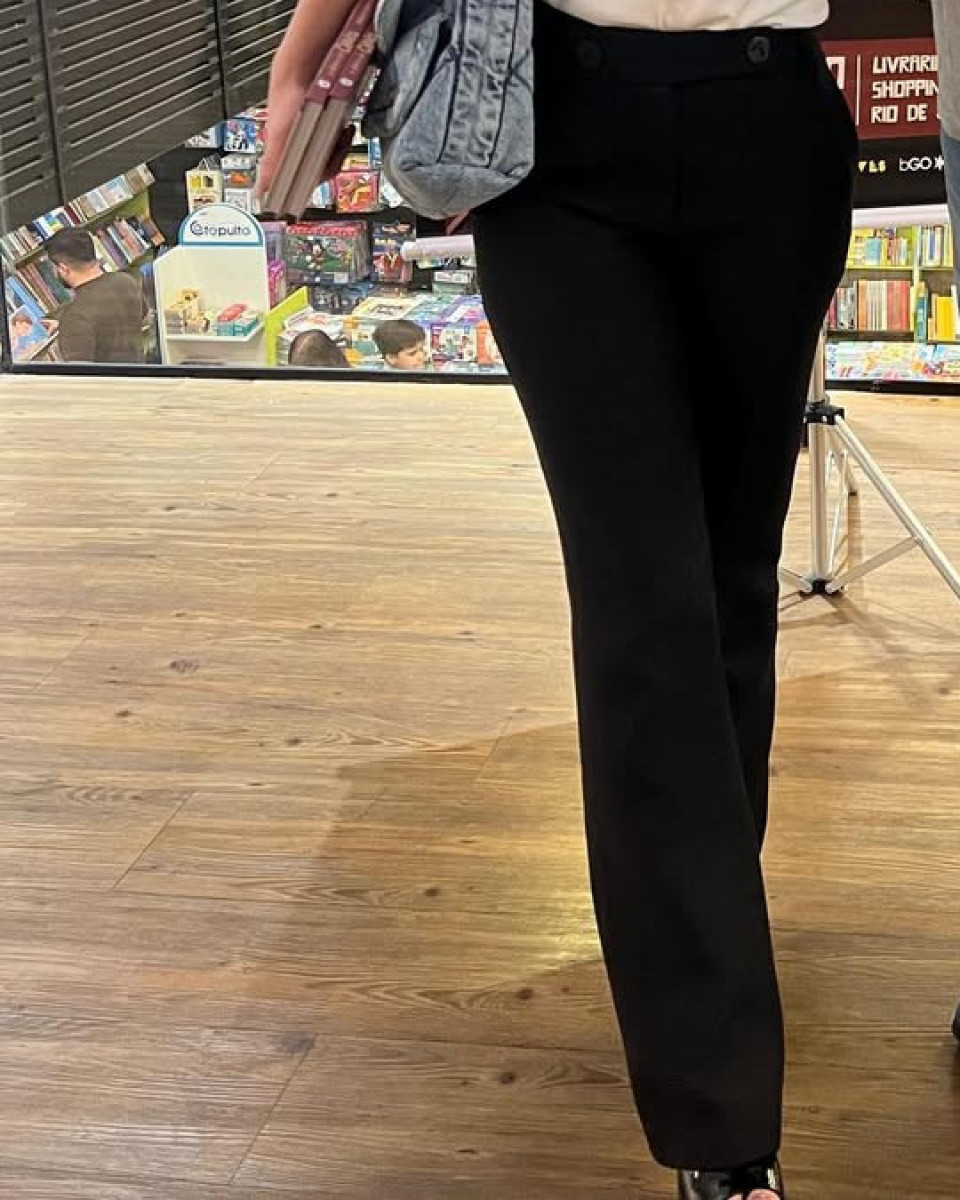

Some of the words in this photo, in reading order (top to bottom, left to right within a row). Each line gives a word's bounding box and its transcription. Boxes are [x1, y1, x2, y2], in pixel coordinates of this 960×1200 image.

[872, 54, 938, 74] LIVRARI
[870, 104, 899, 123] RIO
[906, 103, 928, 121] DE
